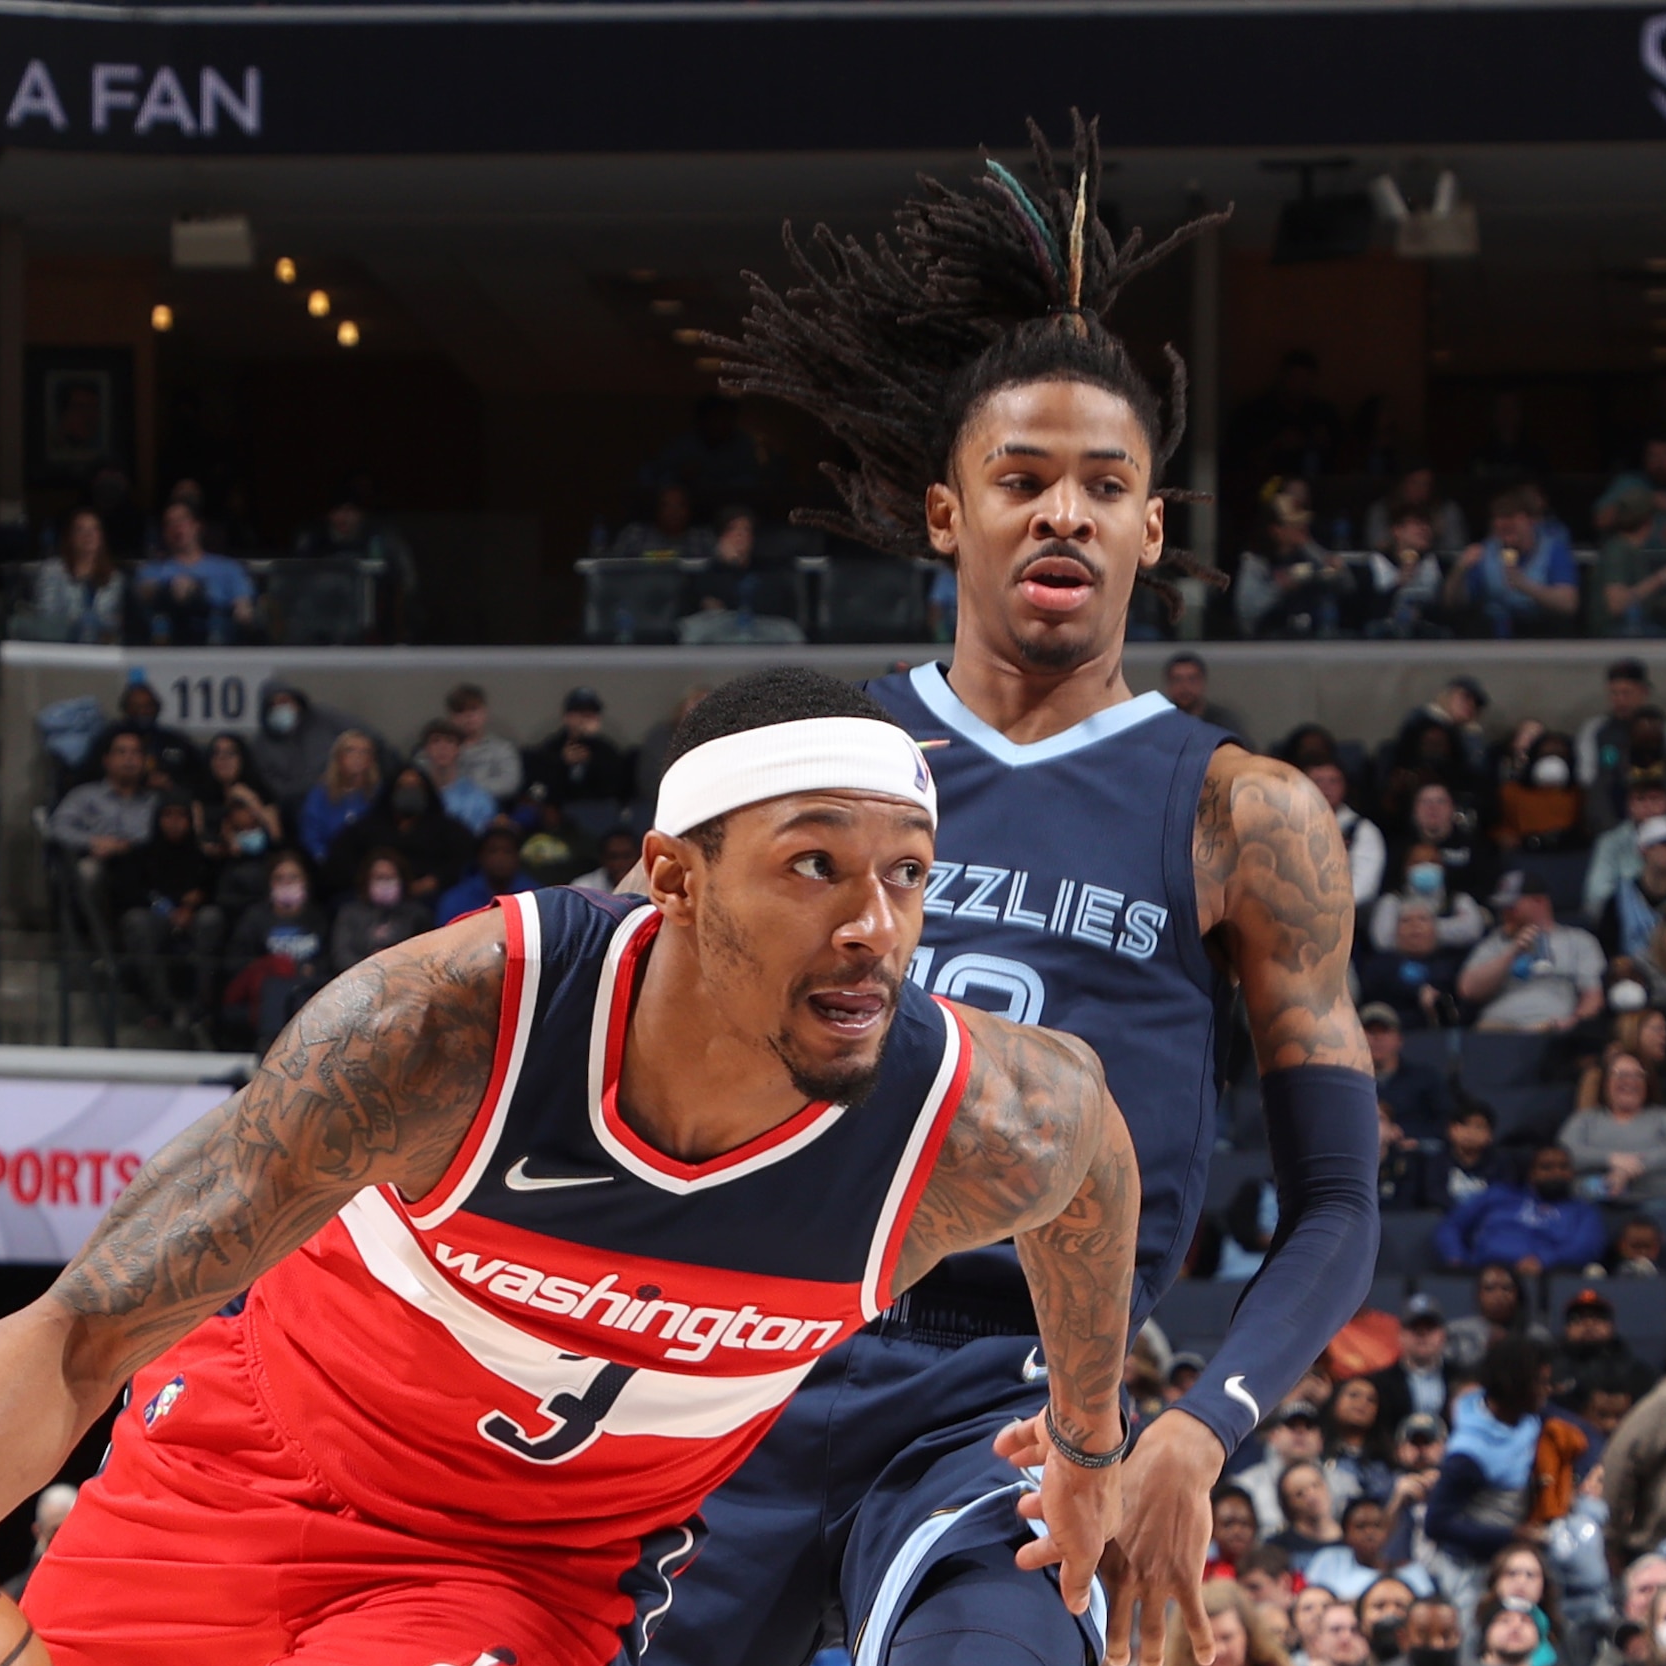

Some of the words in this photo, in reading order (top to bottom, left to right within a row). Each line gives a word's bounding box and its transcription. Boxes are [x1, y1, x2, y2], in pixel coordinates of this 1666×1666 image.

[8, 61, 66, 130] A
[91, 62, 262, 136] FAN
[171, 676, 246, 721] 110
[922, 860, 1169, 960] ZZLIES
[435, 1242, 843, 1362] washington
[477, 1351, 641, 1465] 3
